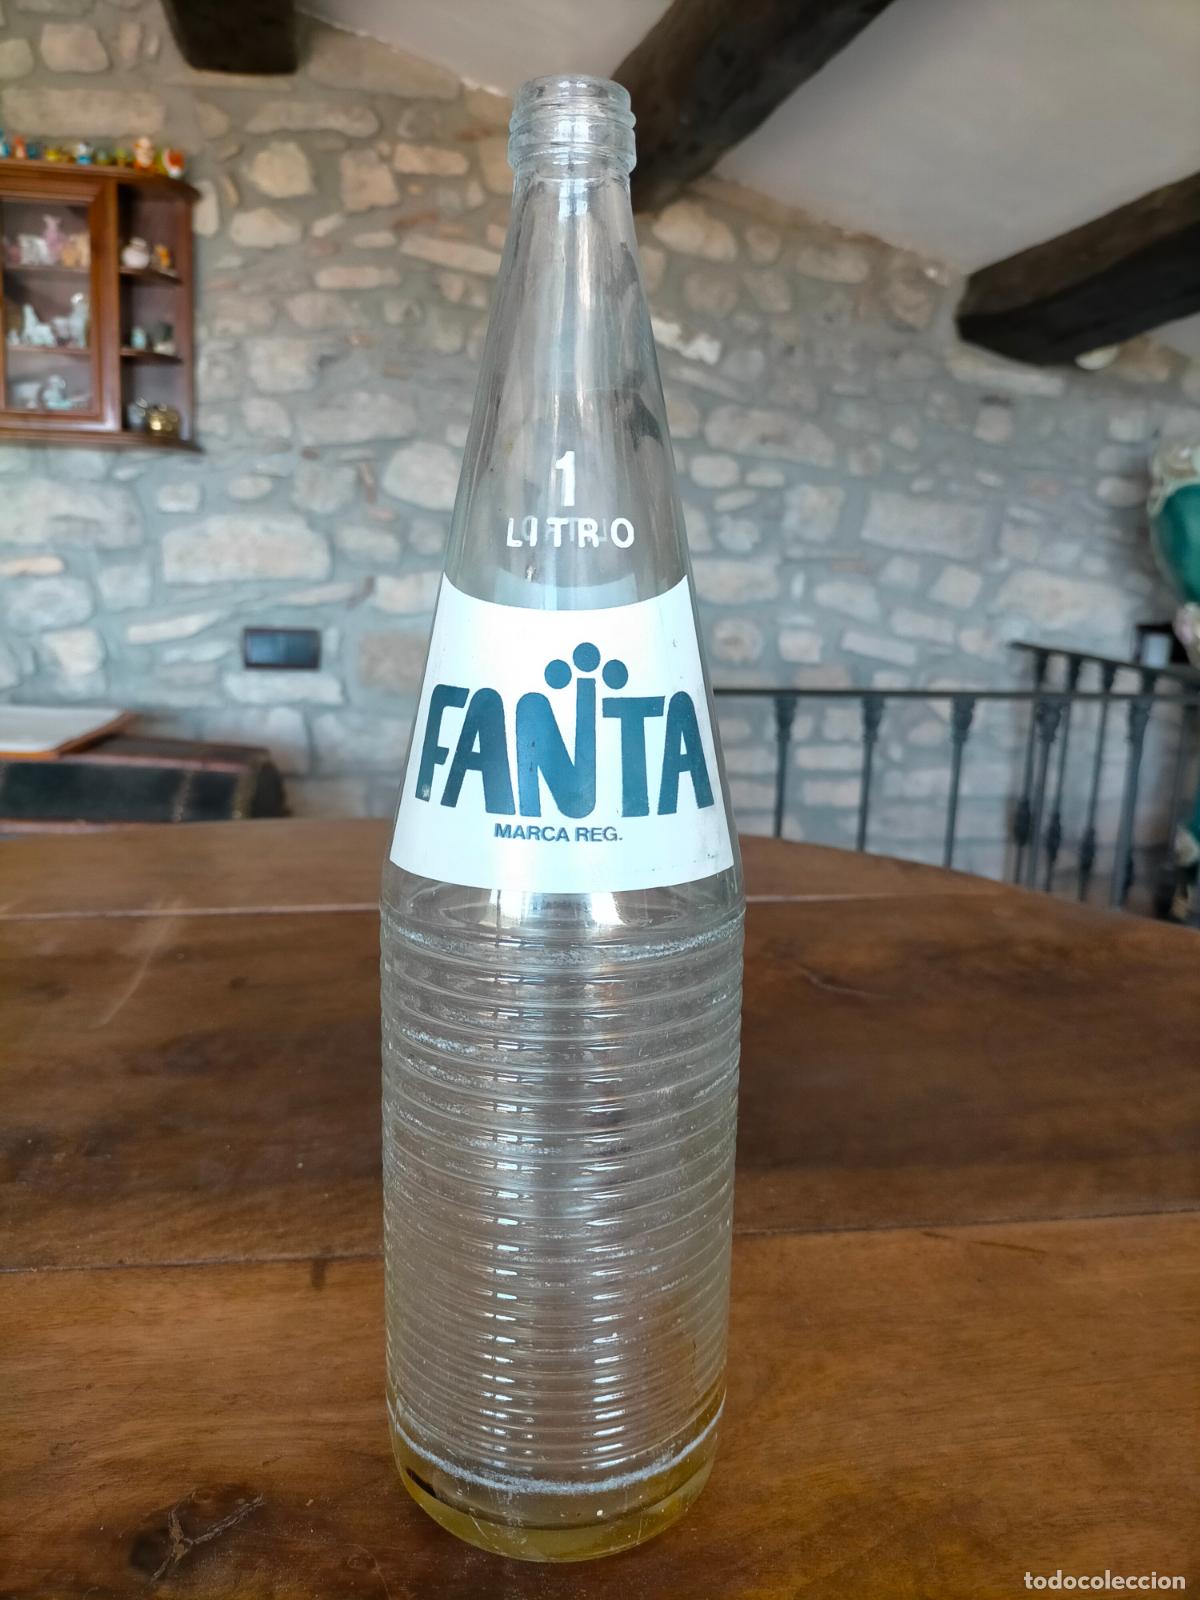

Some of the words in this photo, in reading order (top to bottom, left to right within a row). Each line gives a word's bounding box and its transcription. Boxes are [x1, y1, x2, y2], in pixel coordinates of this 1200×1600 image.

[555, 450, 576, 507] 1
[506, 517, 635, 549] LITRO
[415, 677, 715, 819] FANTA
[494, 822, 570, 842] MARCA
[574, 826, 623, 842] REG.
